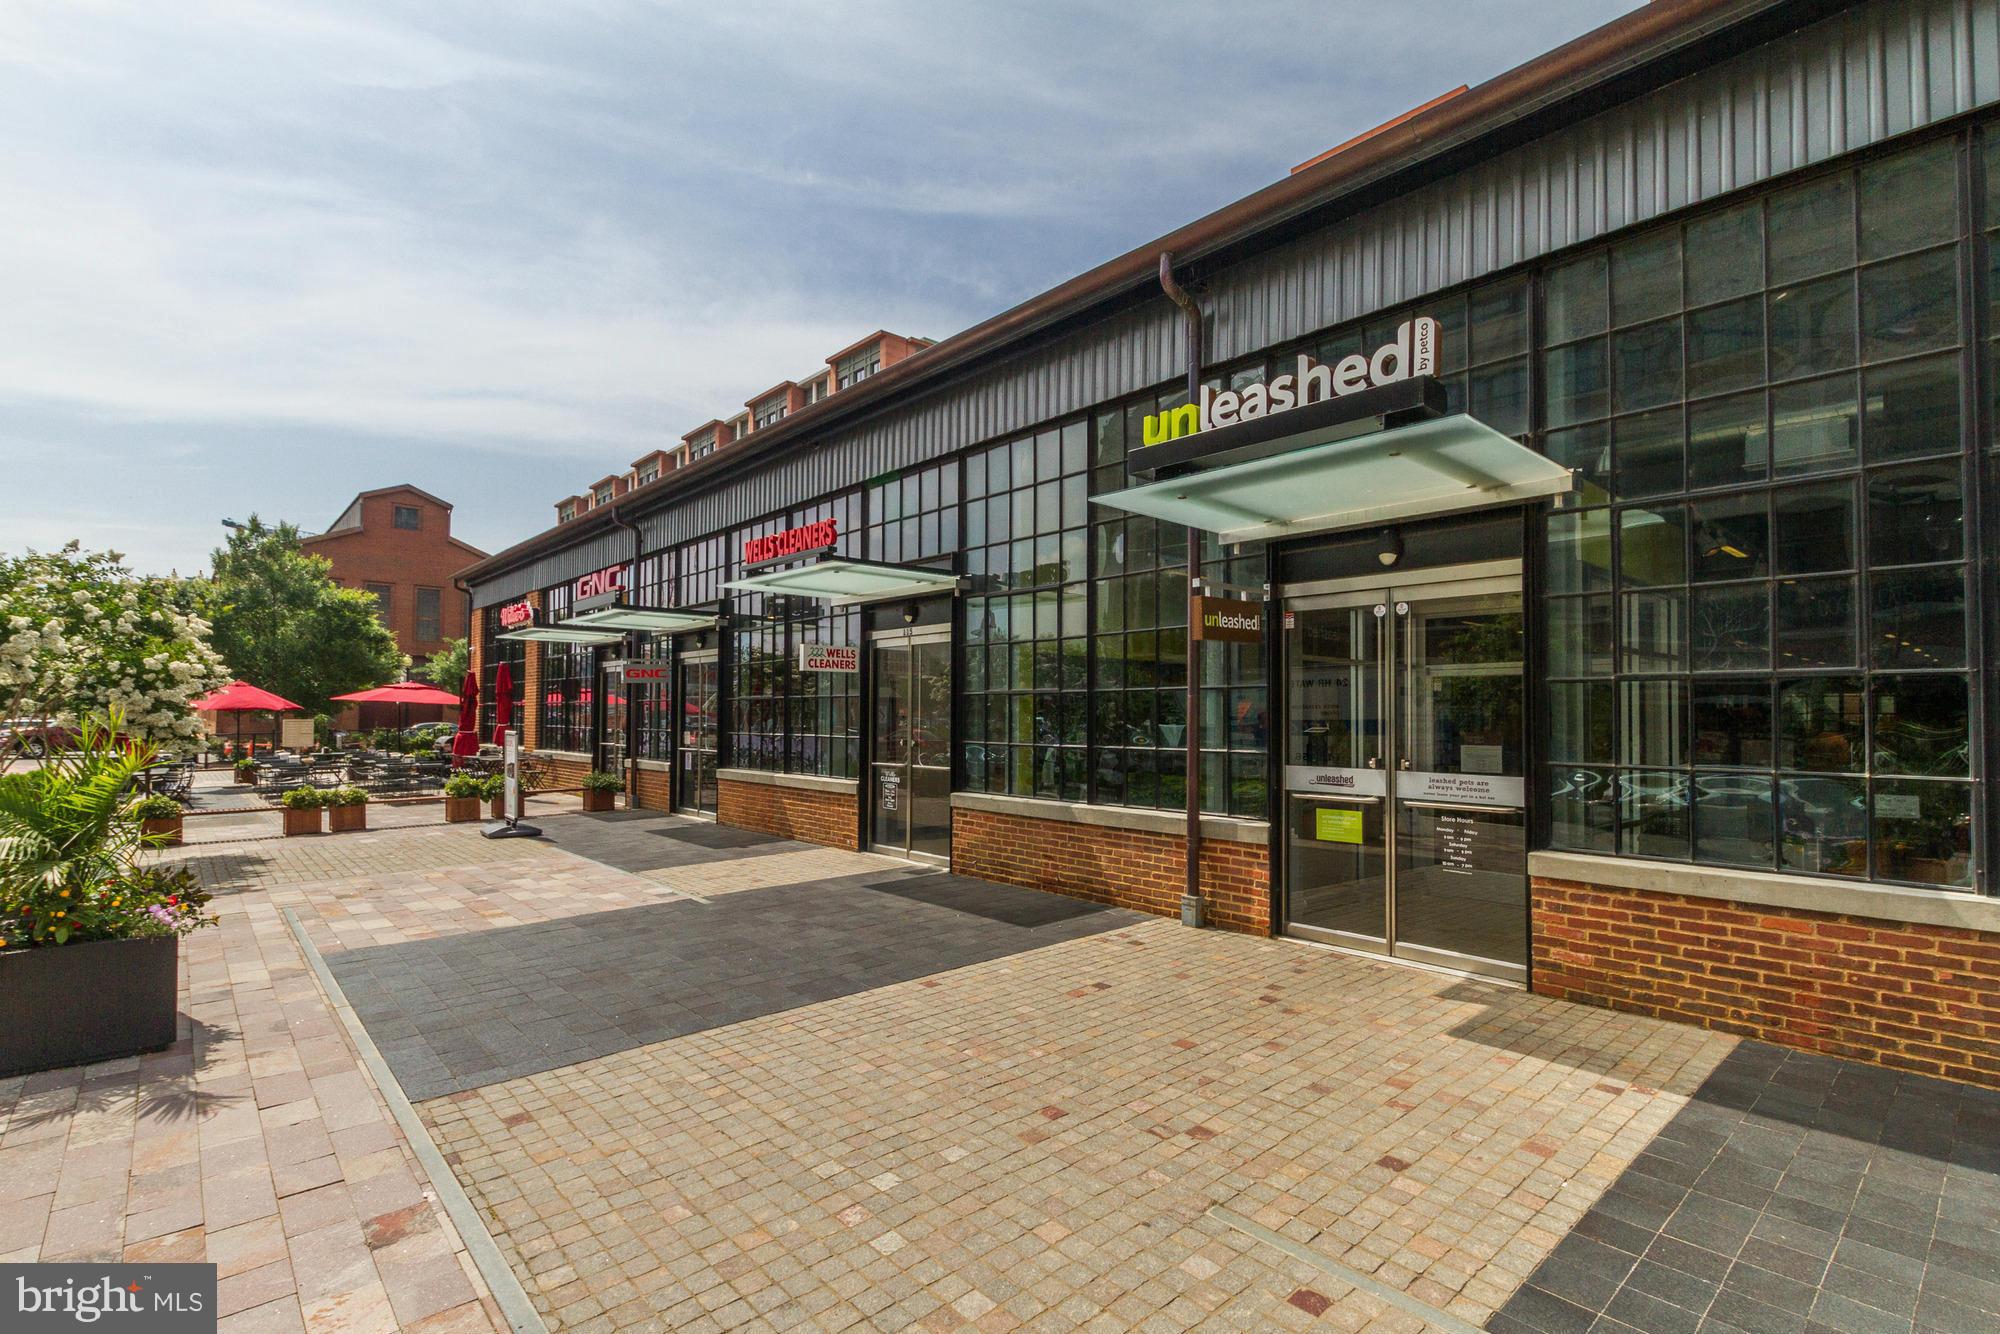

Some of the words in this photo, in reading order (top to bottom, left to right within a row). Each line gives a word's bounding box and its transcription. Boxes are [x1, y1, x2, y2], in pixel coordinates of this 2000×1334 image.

[1419, 322, 1430, 355] petco
[1418, 357, 1430, 371] by
[1142, 320, 1411, 448] unleashed
[745, 534, 776, 565] WELLS
[776, 518, 834, 557] CLEANERS
[577, 565, 622, 600] GNC
[826, 648, 856, 659] WELLS
[808, 658, 856, 670] CLEANERS
[625, 668, 668, 679] GNC
[1316, 774, 1354, 784] unleashed
[1428, 776, 1457, 785] leashed
[1427, 783, 1453, 792] always
[1455, 785, 1490, 794] welcome
[1441, 815, 1456, 823] Store
